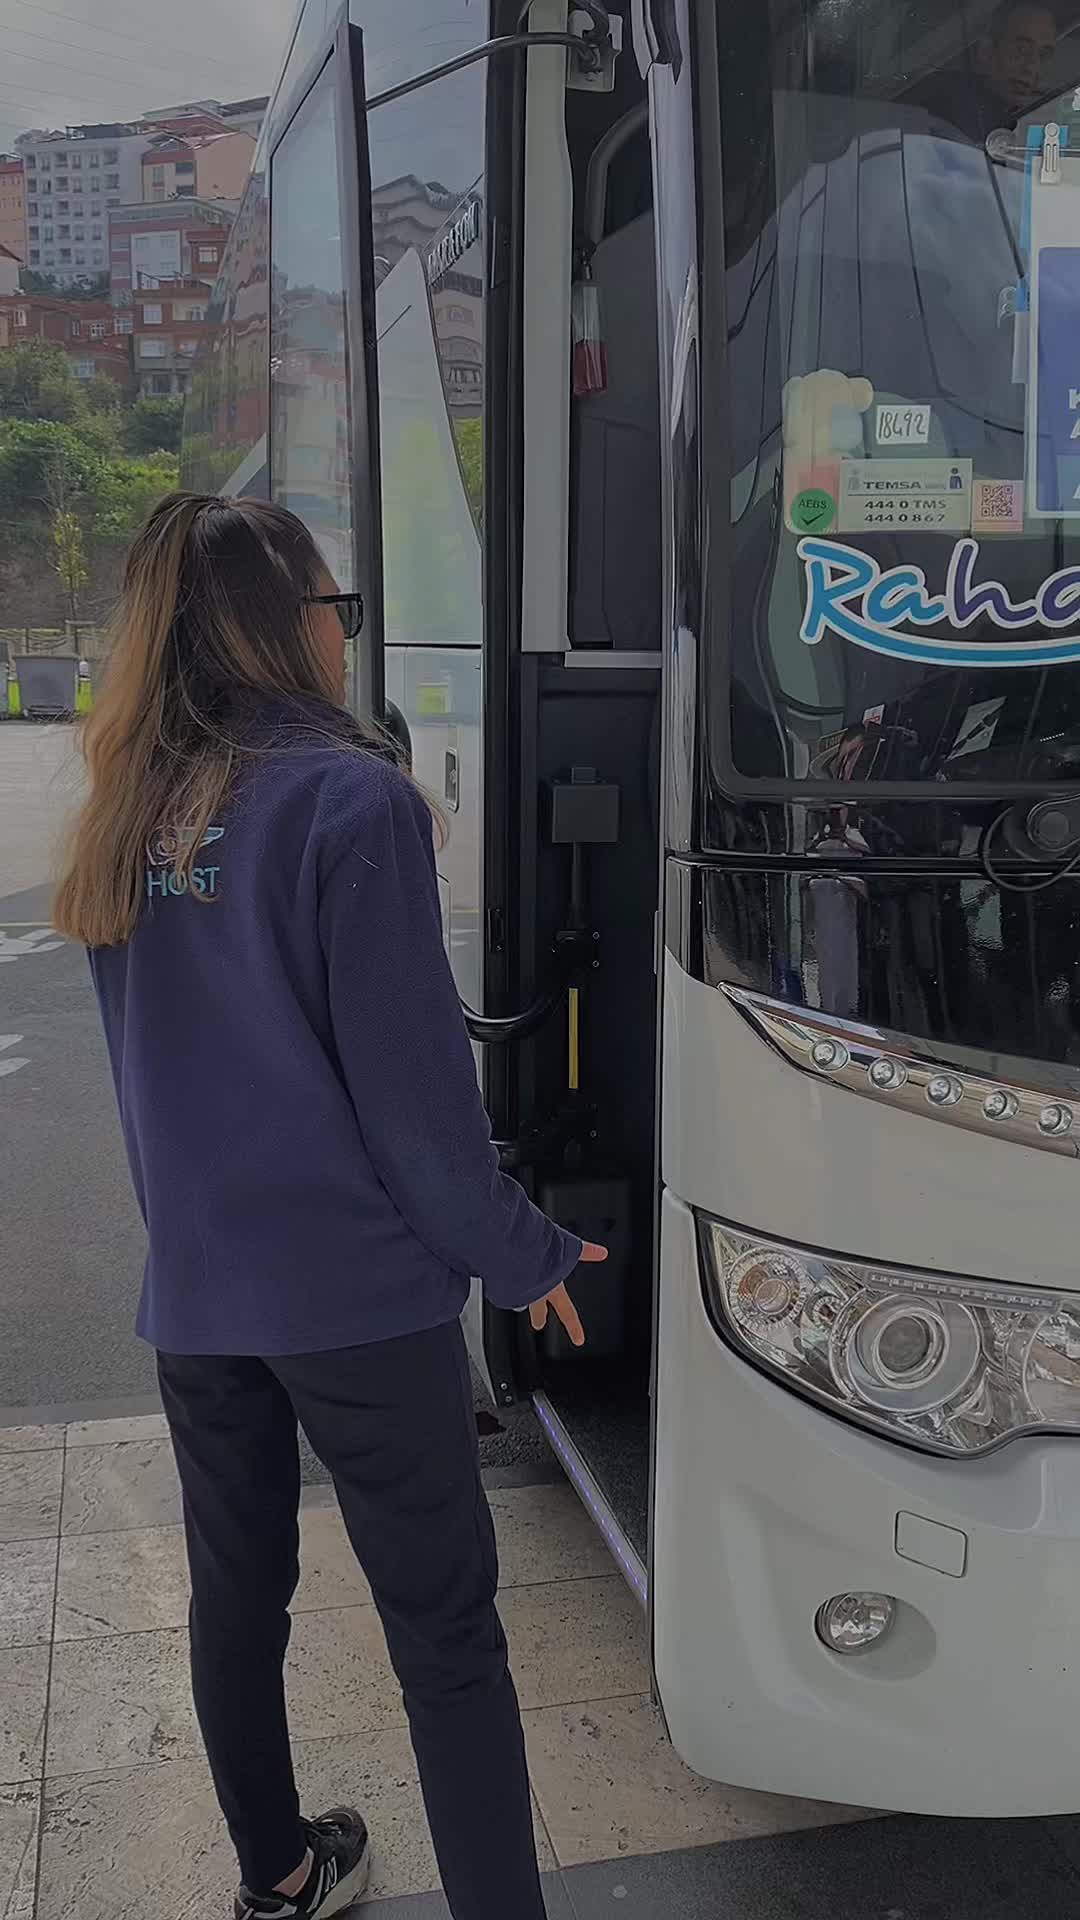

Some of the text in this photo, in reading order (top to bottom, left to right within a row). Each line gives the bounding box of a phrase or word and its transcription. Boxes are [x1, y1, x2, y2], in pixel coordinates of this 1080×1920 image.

[878, 409, 926, 439] 18492
[863, 481, 921, 490] TEMSA
[799, 498, 828, 509] AEBS
[864, 500, 946, 509] 444 0 TMS
[864, 514, 945, 522] 444 0 867
[147, 867, 220, 897] HOST
